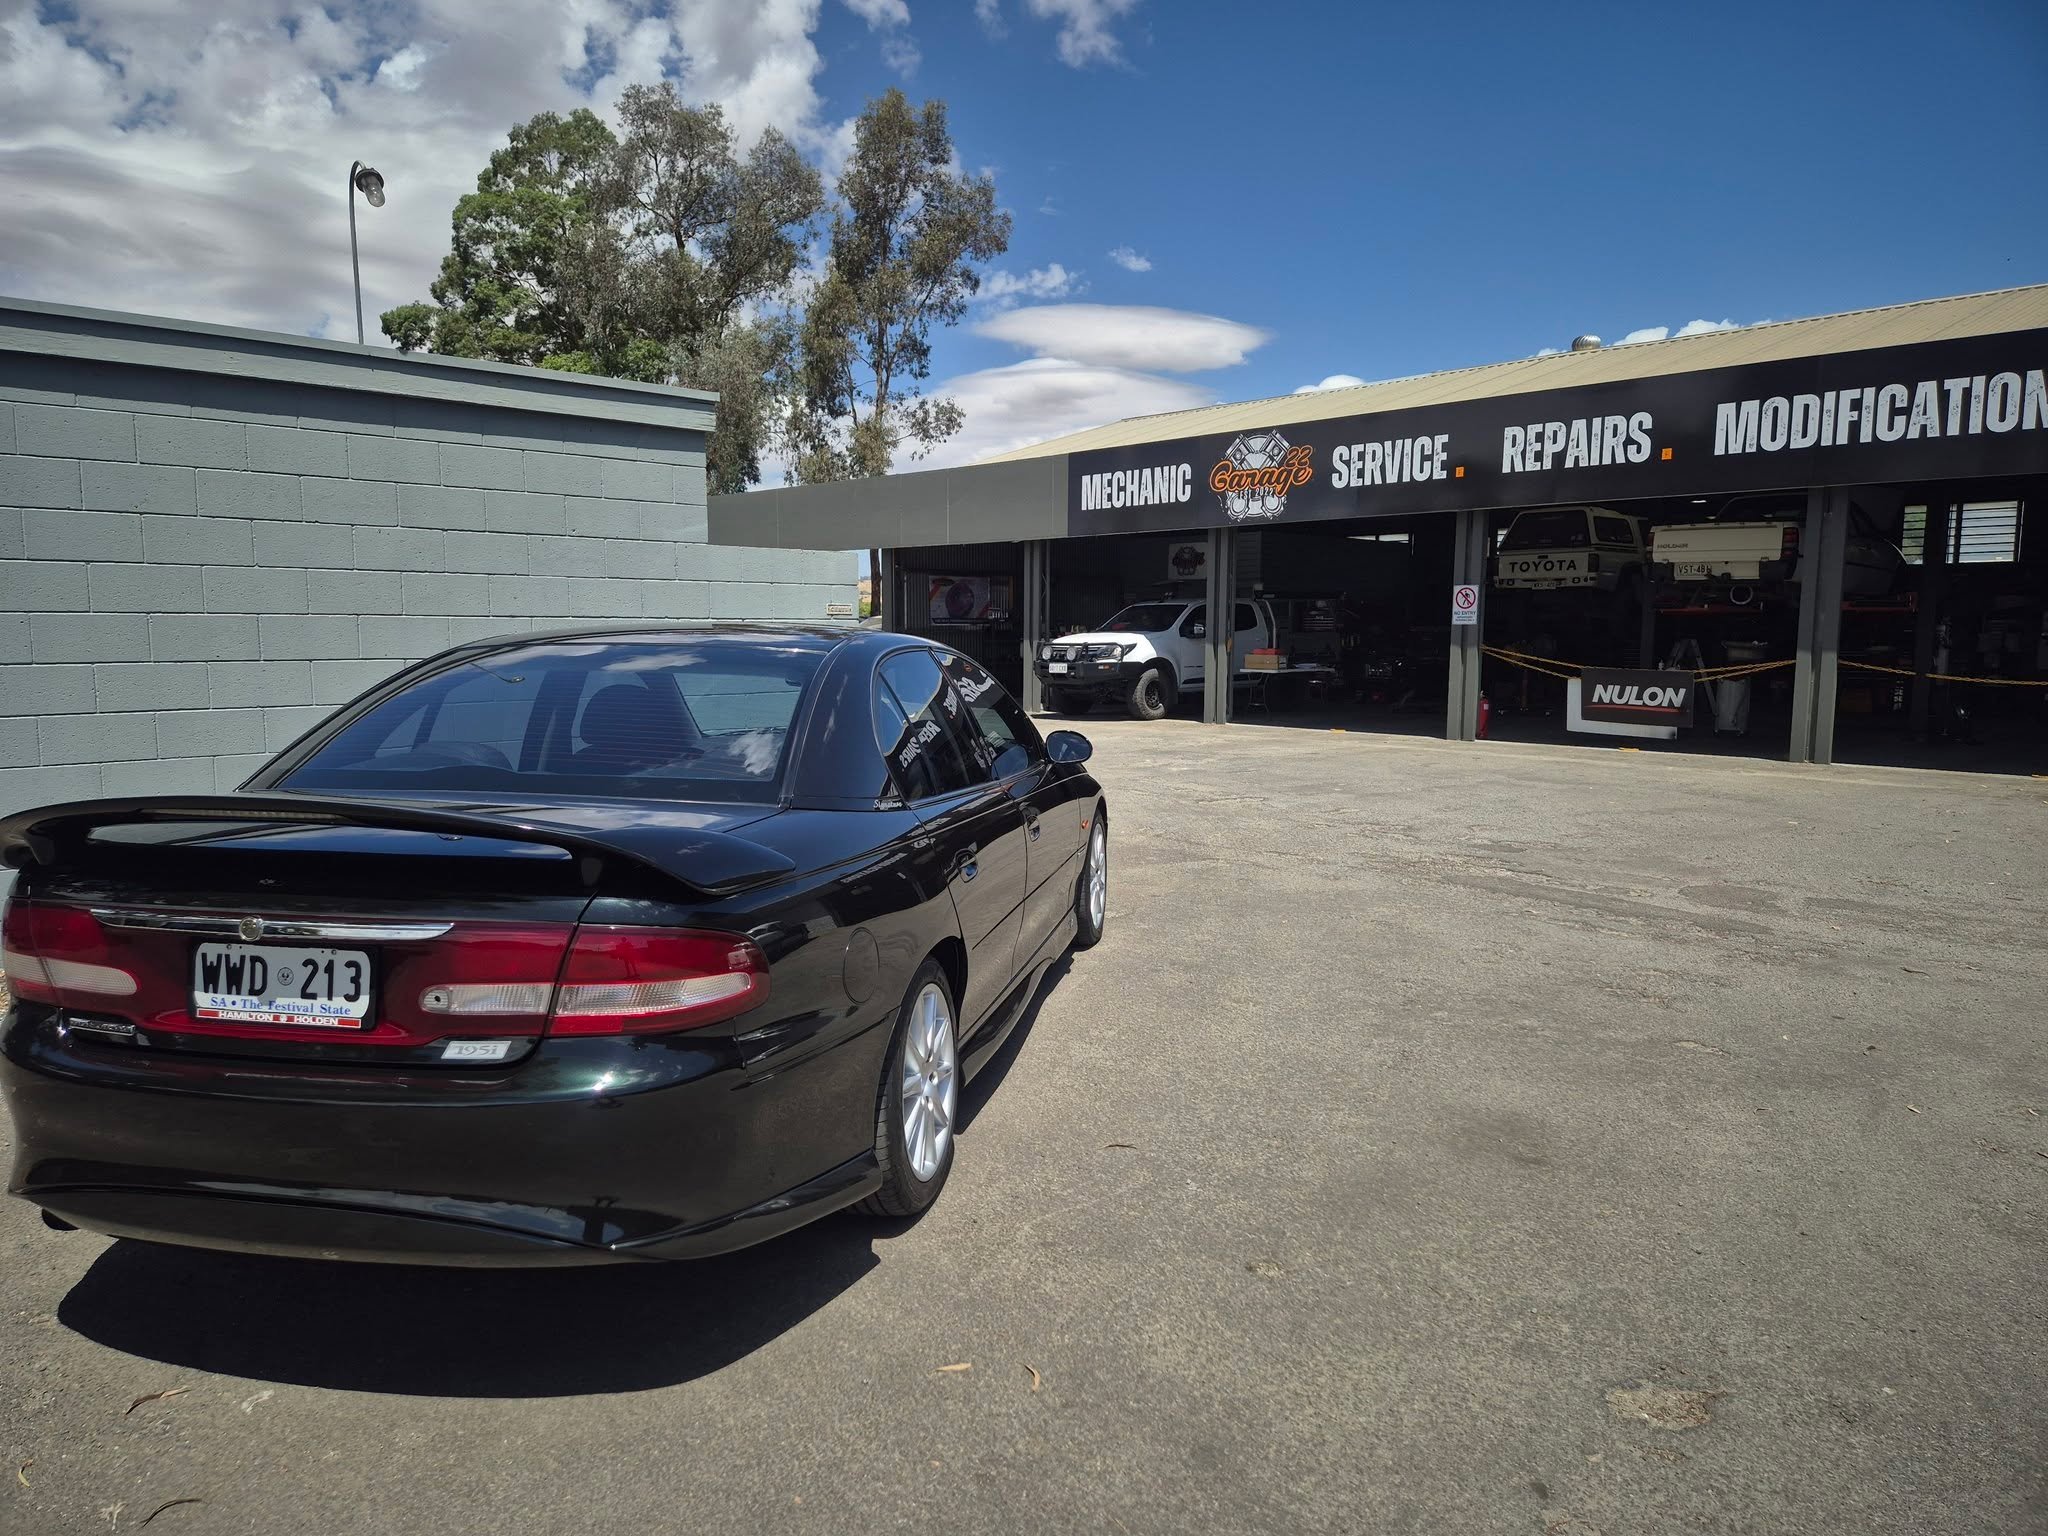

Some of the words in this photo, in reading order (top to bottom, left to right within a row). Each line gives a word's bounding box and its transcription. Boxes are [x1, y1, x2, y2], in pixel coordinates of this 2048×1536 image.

[1209, 460, 1313, 497] Garage
[1284, 445, 1313, 469] 22
[1081, 463, 1192, 511] MECHANIC
[1255, 486, 1274, 497] 2022
[1509, 559, 1577, 573] TOYOTA
[1592, 684, 1686, 707] NULON
[201, 952, 268, 997] WWD
[301, 958, 362, 1003] 213
[210, 997, 227, 1008] SA
[241, 998, 263, 1010] The
[268, 1000, 314, 1014] Festival
[320, 1004, 350, 1015] State
[219, 1010, 273, 1022] HAMILTON
[293, 1016, 338, 1026] HOLDEN
